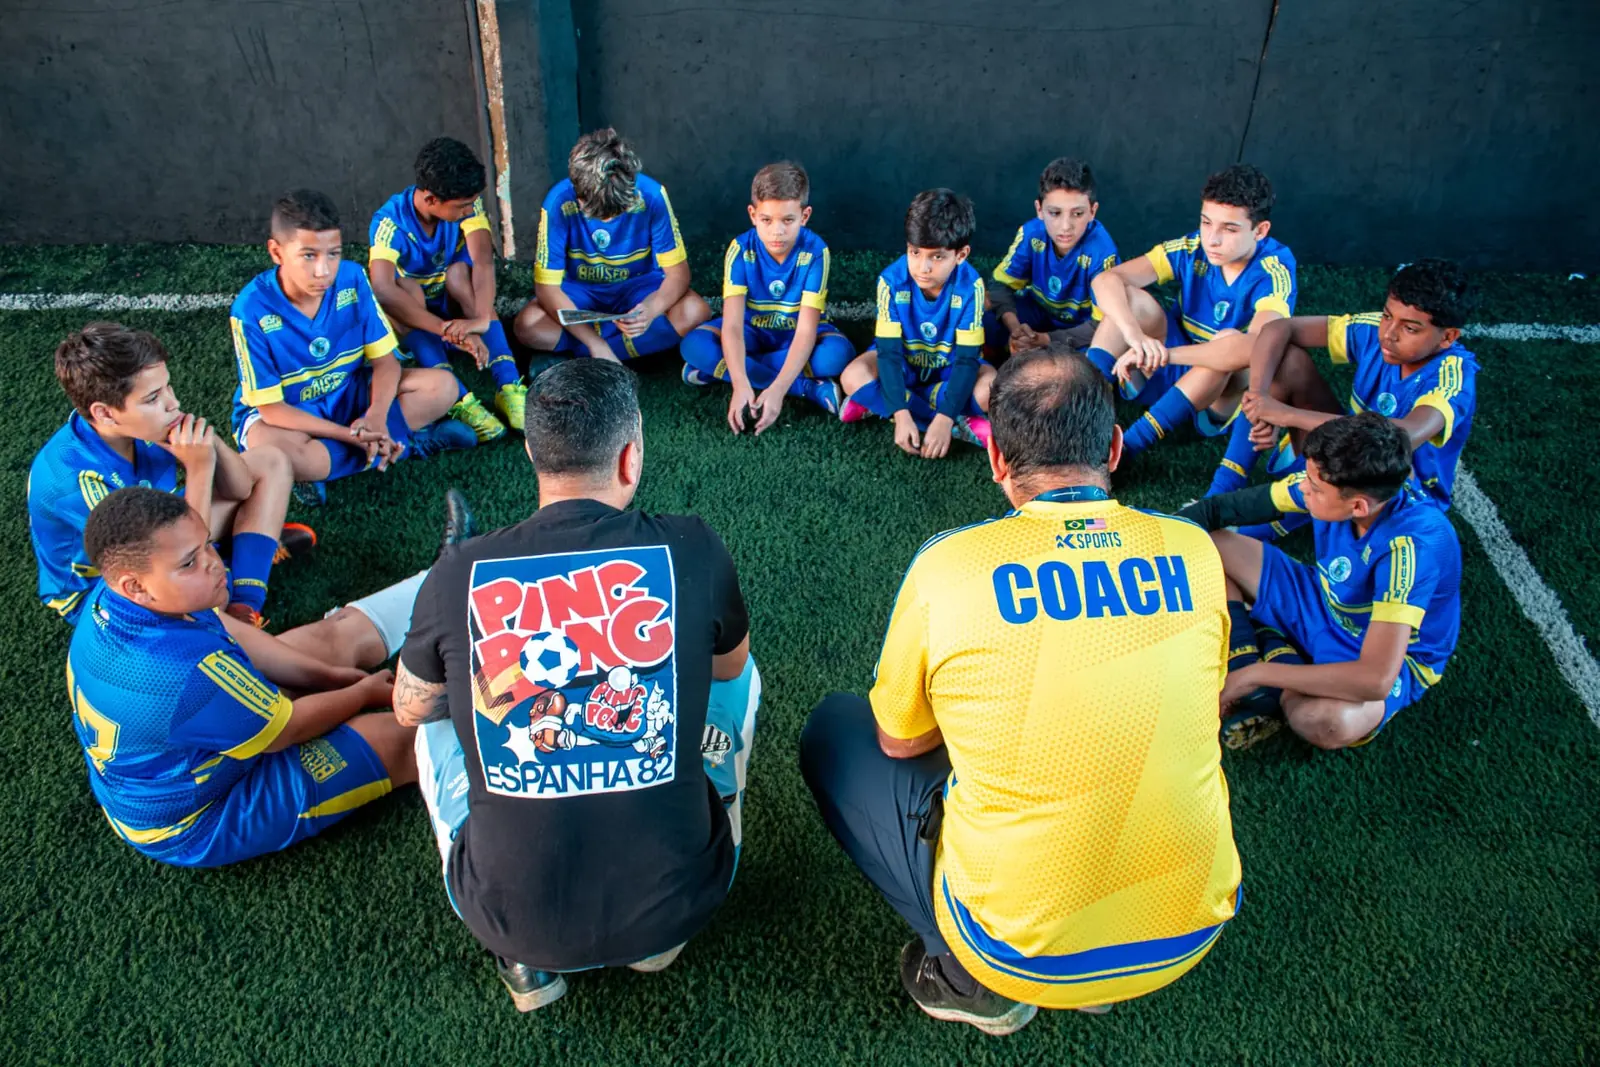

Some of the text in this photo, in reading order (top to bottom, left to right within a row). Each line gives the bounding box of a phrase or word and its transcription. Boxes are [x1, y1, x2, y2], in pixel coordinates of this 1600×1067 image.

[1076, 531, 1122, 549] SPORTS
[470, 559, 648, 638] PING
[992, 555, 1194, 624] COACH
[590, 681, 648, 707] PING
[486, 760, 634, 794] ESPANHA
[637, 754, 673, 784] 82
